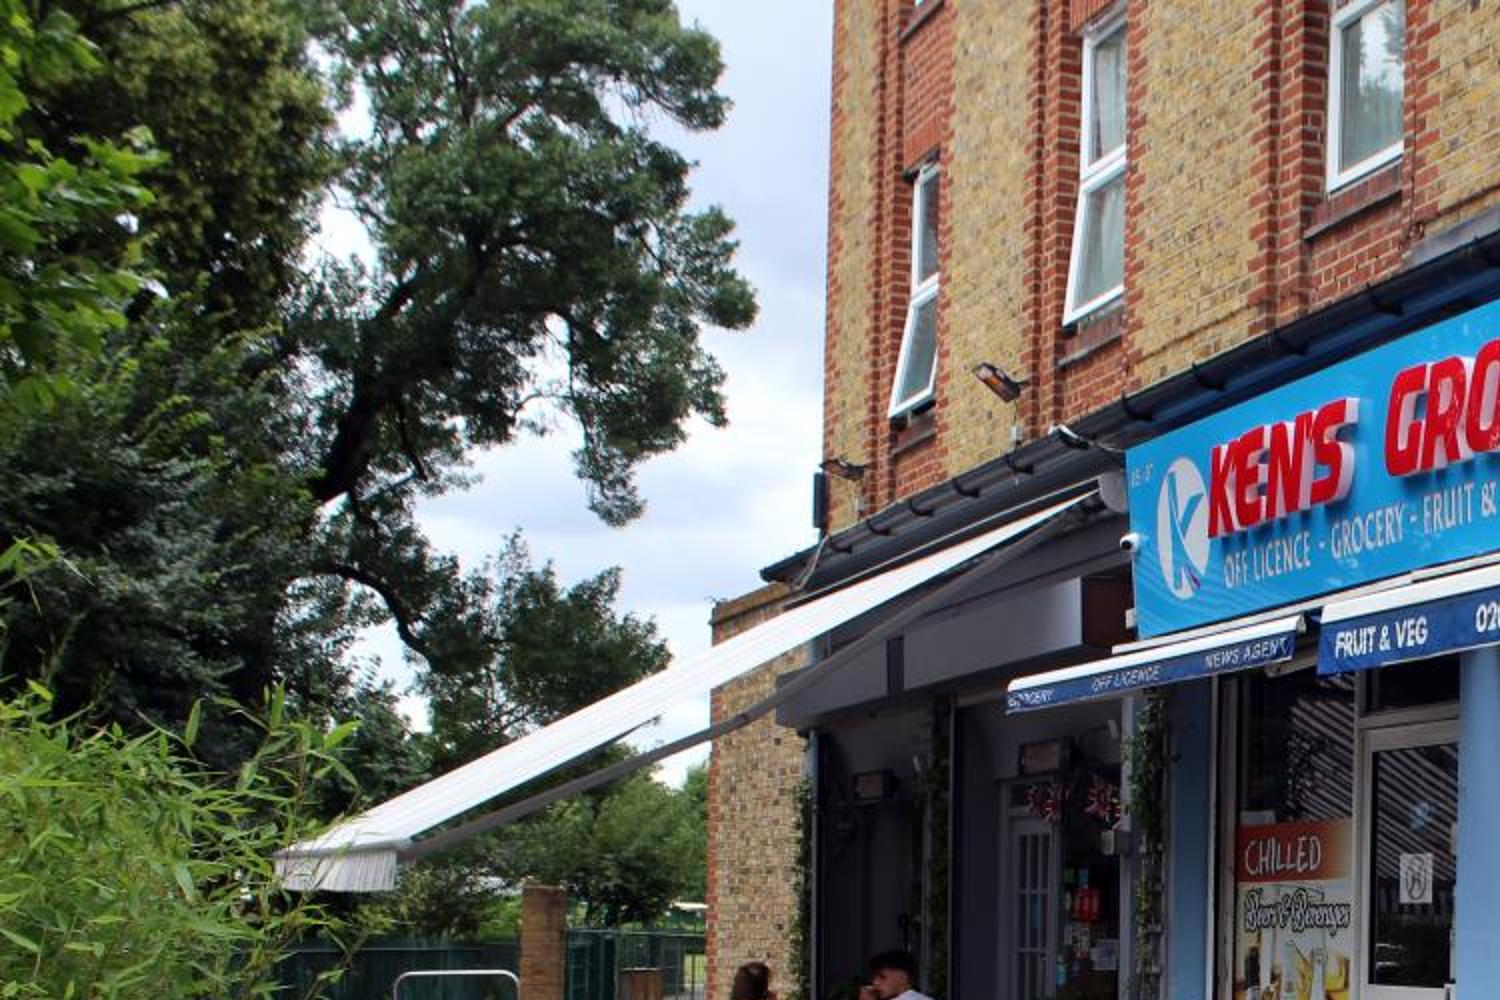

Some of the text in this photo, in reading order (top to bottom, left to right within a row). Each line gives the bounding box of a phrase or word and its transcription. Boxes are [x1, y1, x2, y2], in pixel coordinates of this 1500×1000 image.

[1207, 398, 1357, 540] KEN'S
[1223, 553, 1250, 589] OFF
[1253, 533, 1312, 579] LICENCE
[1331, 503, 1407, 560] GROCERY
[1423, 483, 1475, 534] FRUIT
[1481, 479, 1498, 511] &
[1335, 615, 1429, 660] FRUIT & VEG
[1204, 651, 1241, 671] NEWS
[1245, 836, 1321, 876] CHILLED
